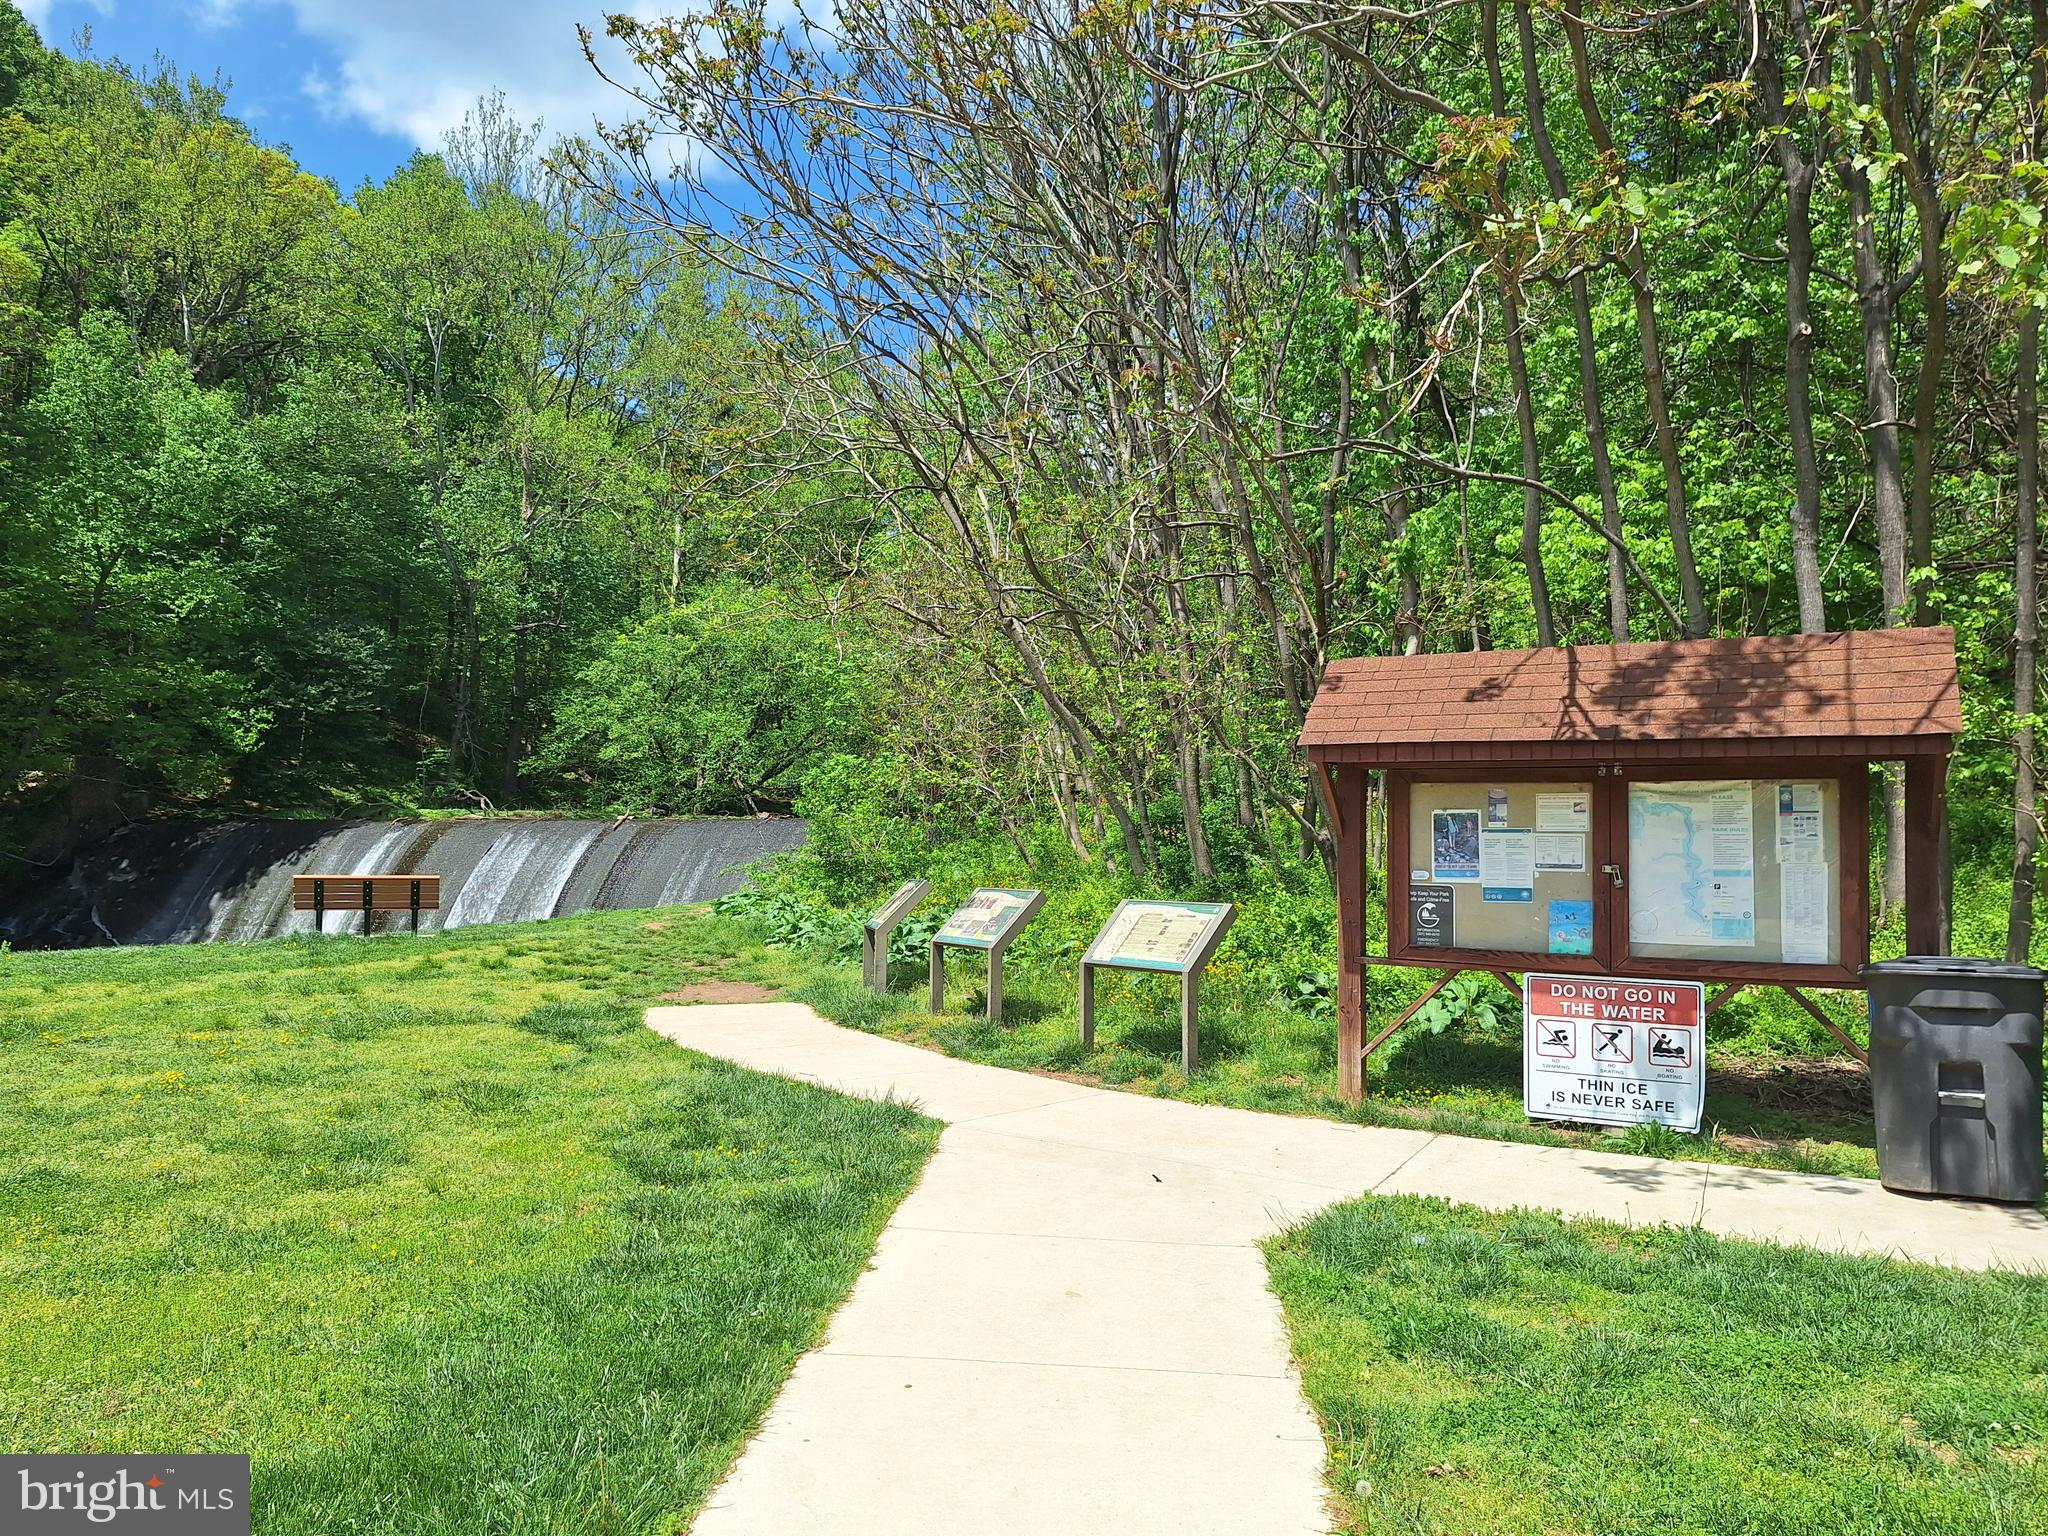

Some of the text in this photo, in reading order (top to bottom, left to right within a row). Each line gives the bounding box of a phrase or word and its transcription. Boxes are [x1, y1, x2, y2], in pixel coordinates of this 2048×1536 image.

[1550, 983, 1676, 1005] DO NOT GO IN
[1560, 1001, 1666, 1022] THE WATER
[1578, 1078, 1648, 1096] THIN ICE
[1551, 1091, 1566, 1103] IS
[1571, 1092, 1626, 1109] NEVER
[1632, 1098, 1675, 1113] SAFE
